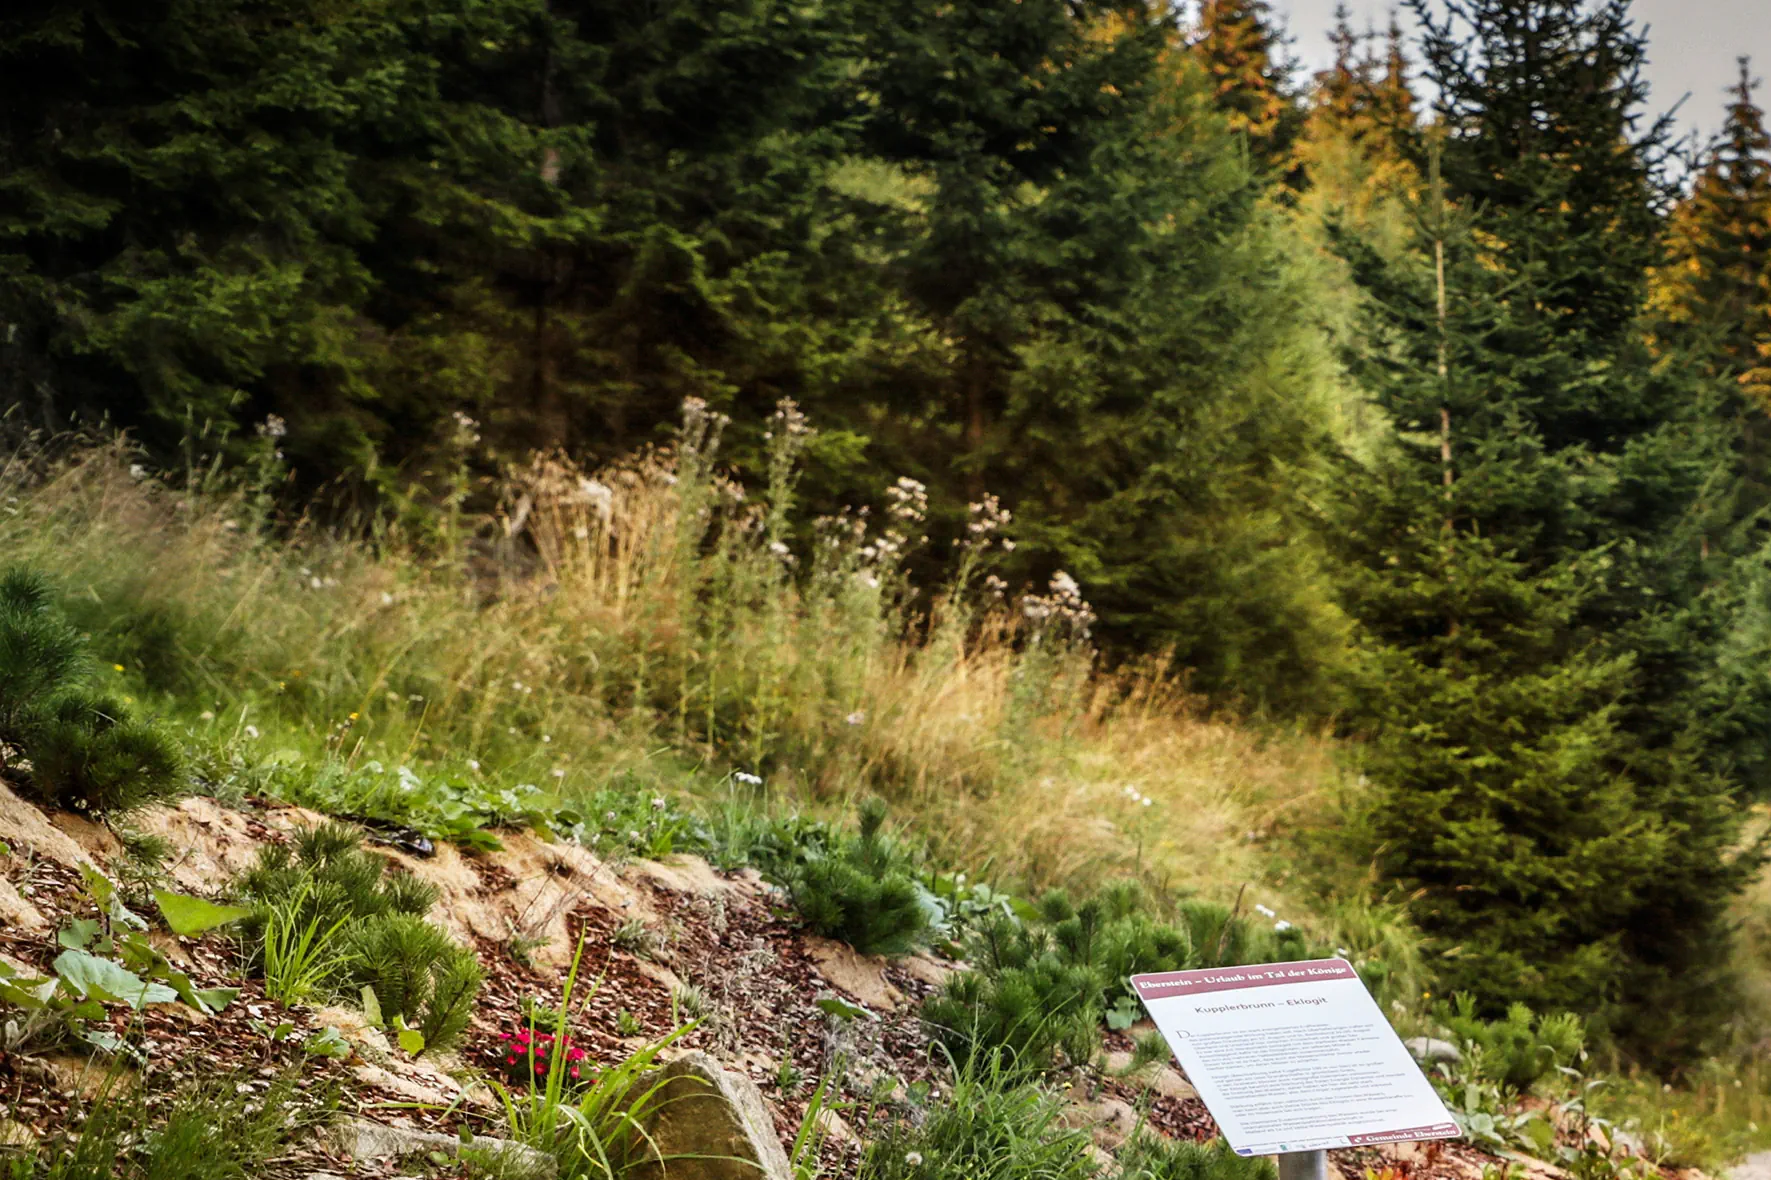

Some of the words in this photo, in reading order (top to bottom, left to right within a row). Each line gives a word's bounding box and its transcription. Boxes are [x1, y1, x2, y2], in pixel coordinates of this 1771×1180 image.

[1139, 979, 1192, 990] Eberstein
[1203, 974, 1245, 985] Urlaub
[1248, 972, 1263, 981] im
[1264, 970, 1285, 979] Tal
[1287, 968, 1306, 977] der
[1307, 965, 1347, 976] Könige
[1195, 1001, 1275, 1014] Kupplerbrunn
[1287, 997, 1328, 1006] Eklogit
[1366, 1133, 1413, 1142] Gemeinde
[1415, 1129, 1457, 1138] Eberstein
